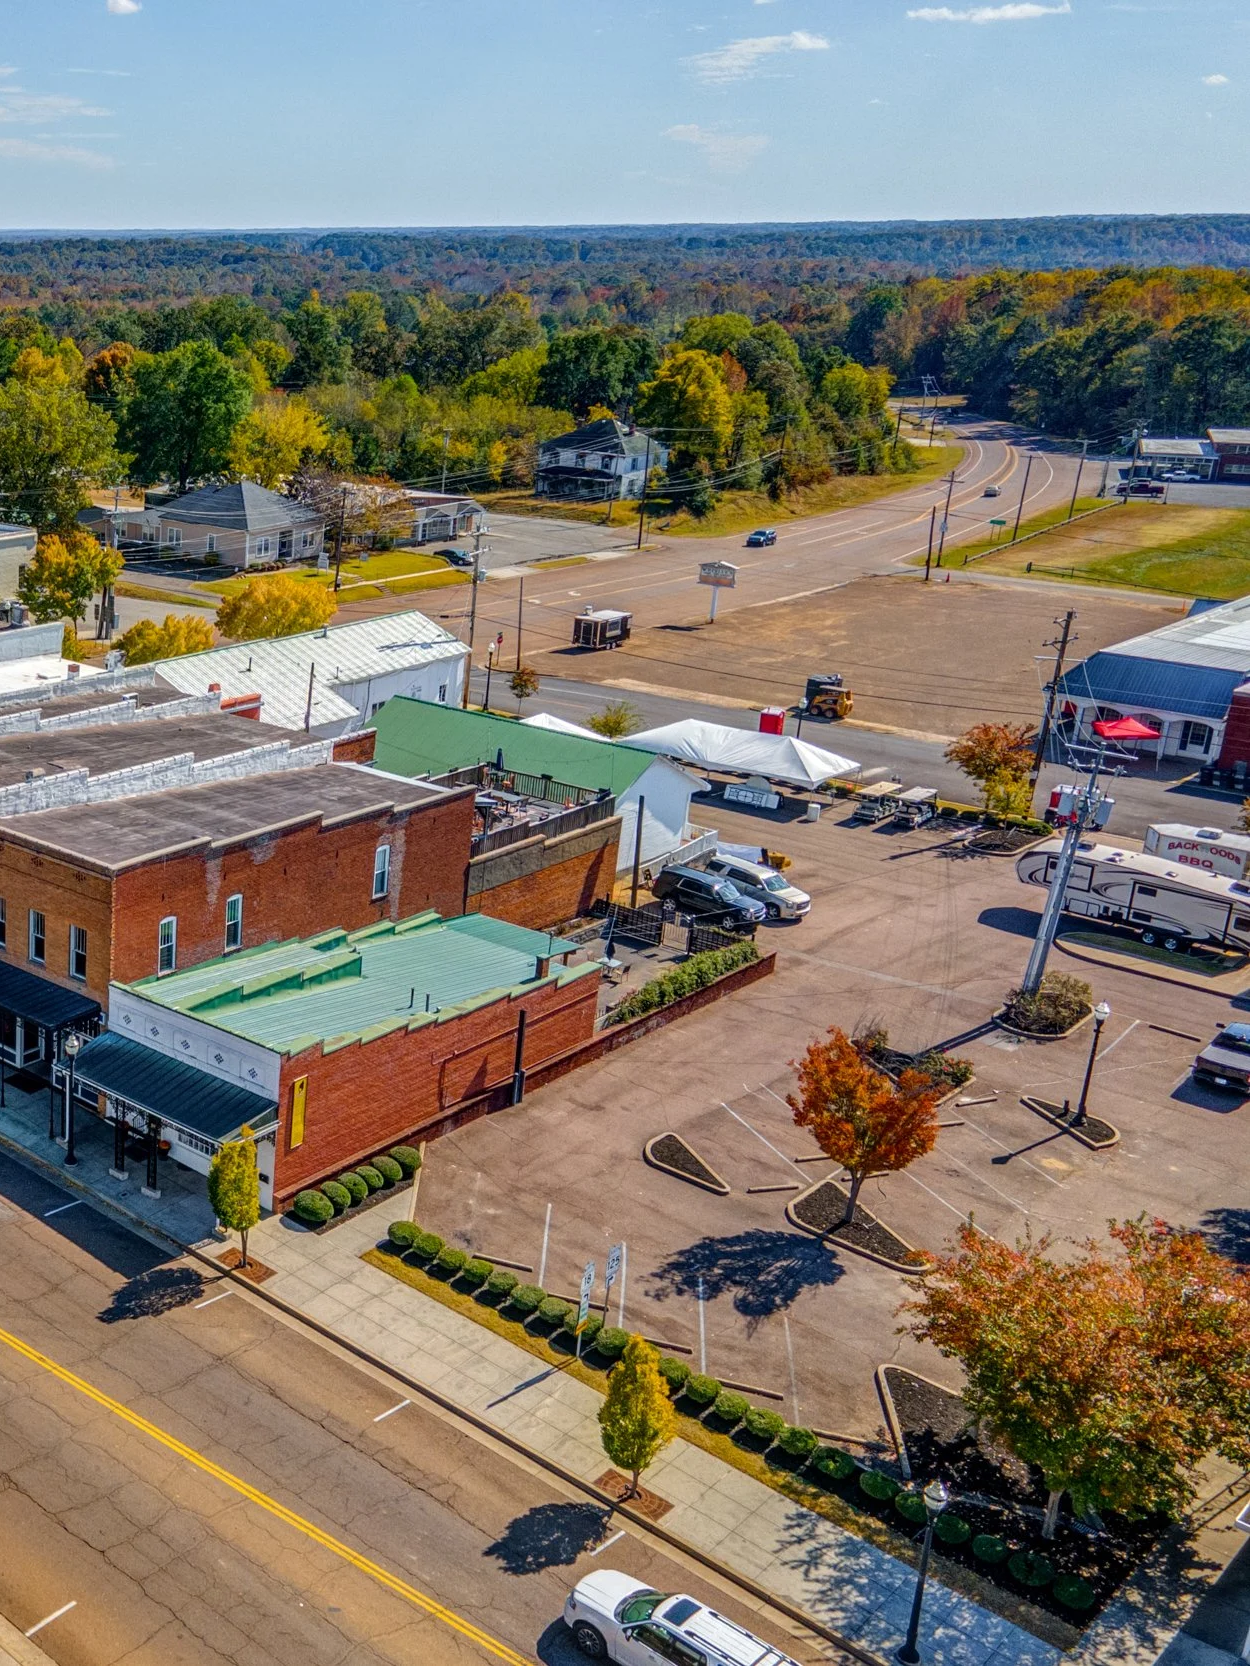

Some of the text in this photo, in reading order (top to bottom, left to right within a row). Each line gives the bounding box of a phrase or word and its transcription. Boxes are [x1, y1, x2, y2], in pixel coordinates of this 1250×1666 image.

[1178, 855, 1214, 869] BBQ
[607, 1255, 620, 1271] 125
[584, 1273, 592, 1286] 18
